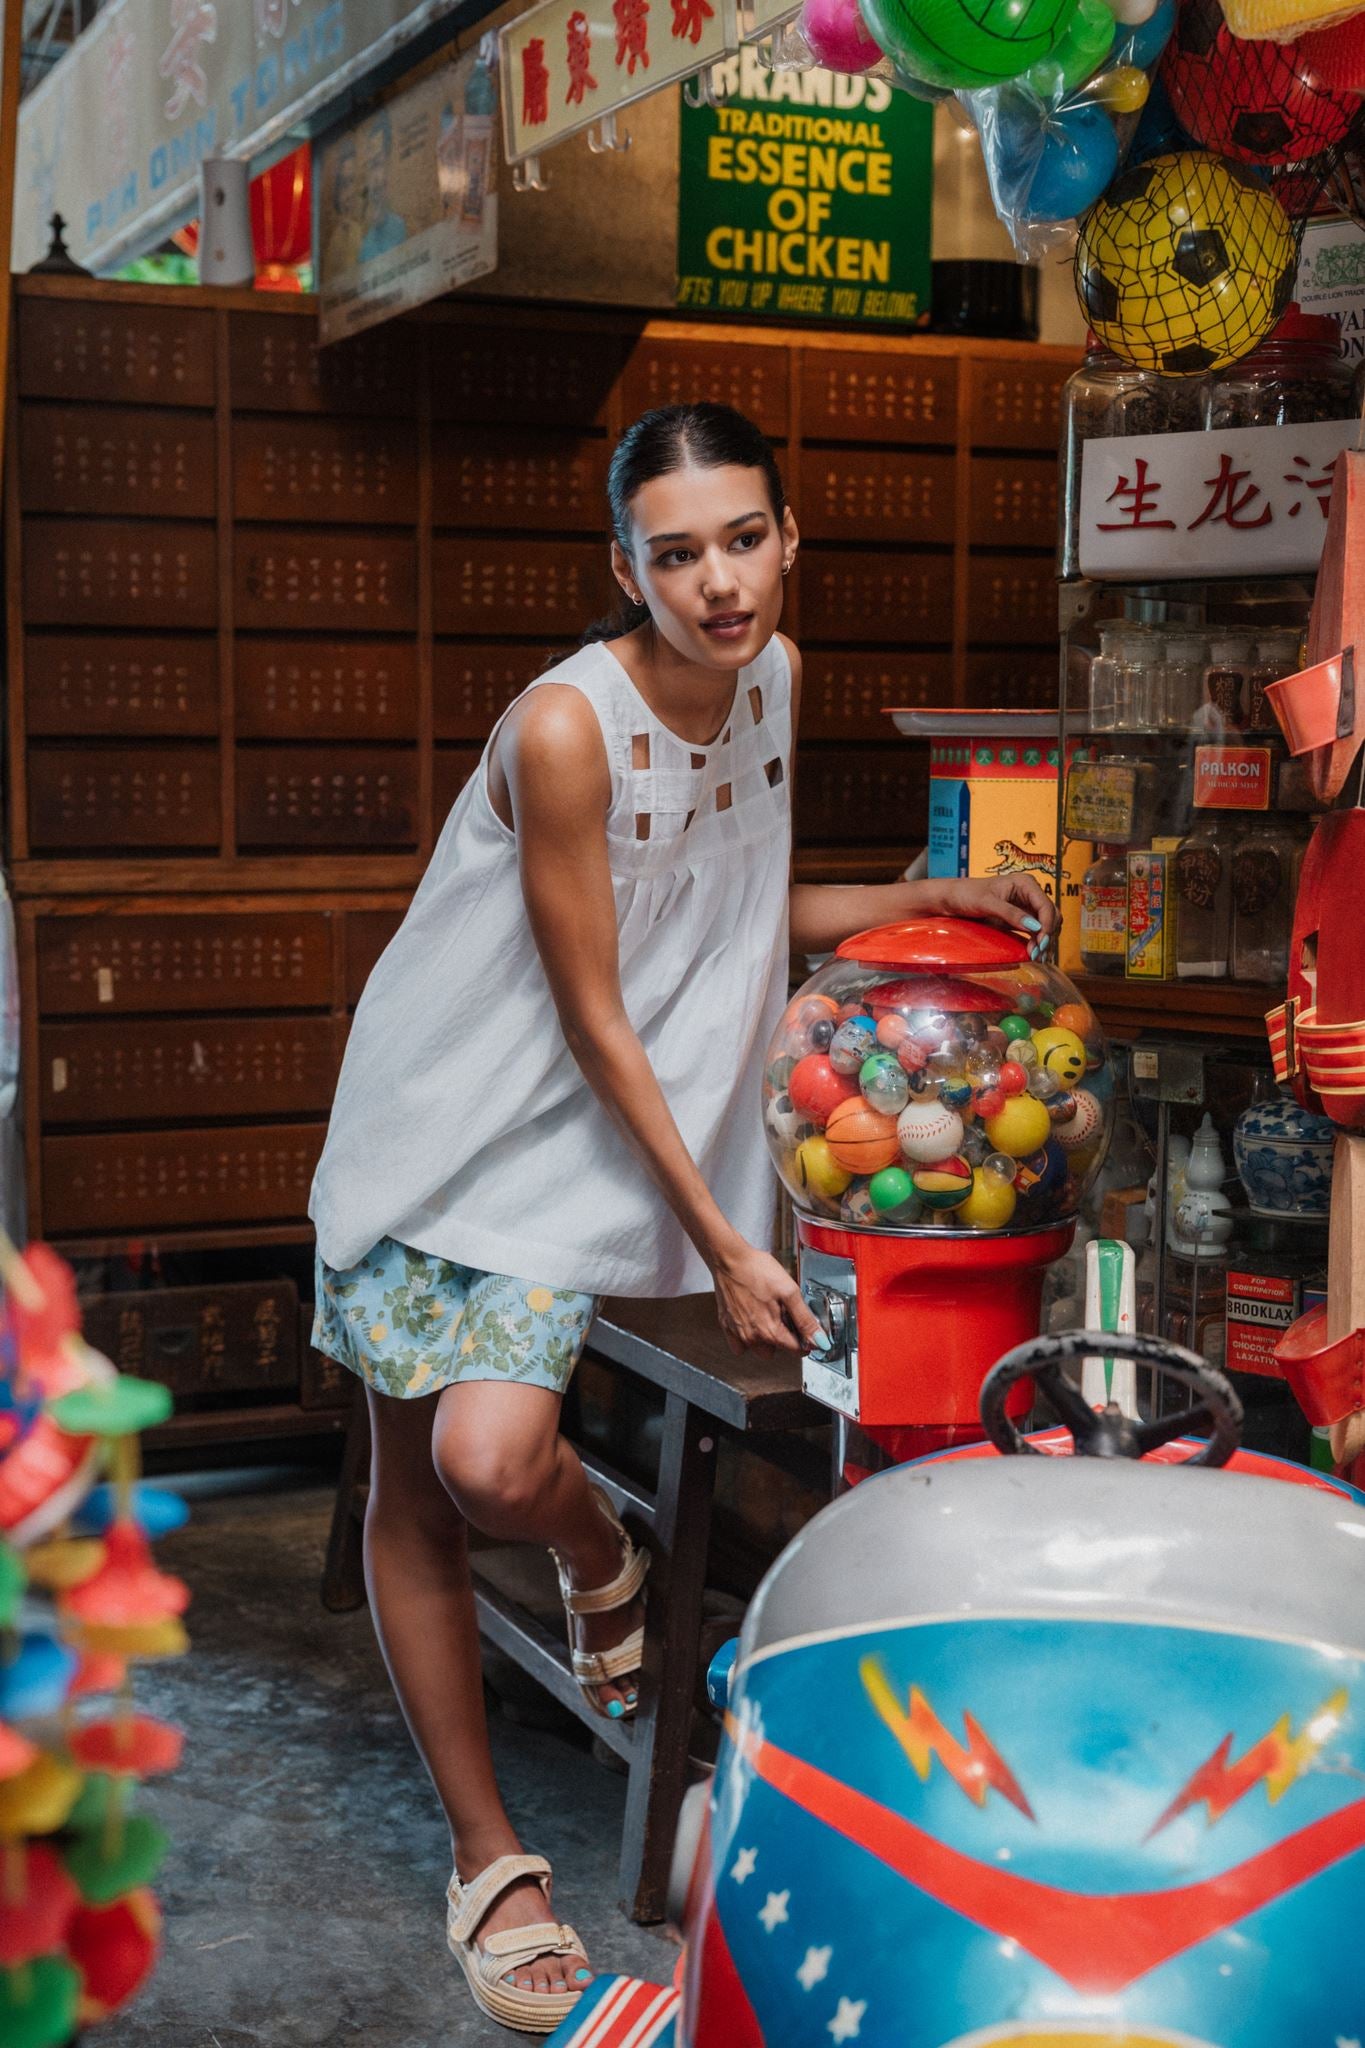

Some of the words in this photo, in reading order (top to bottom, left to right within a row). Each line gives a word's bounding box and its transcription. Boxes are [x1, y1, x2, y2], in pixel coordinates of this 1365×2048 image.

[230, 2, 345, 127] TONG
[715, 107, 885, 149] TRADITIONAL
[708, 136, 892, 197] ESSENCE
[766, 187, 832, 234] OF
[705, 225, 891, 284] CHICKEN
[718, 279, 748, 307] YOU
[751, 281, 774, 309] UP
[777, 283, 827, 314] WHERE
[831, 286, 862, 316] YOU
[1301, 293, 1328, 303] DOUBLE
[1328, 291, 1344, 301] LION
[1200, 761, 1260, 777] PALKON
[1251, 1277, 1266, 1285] FOR
[1227, 1300, 1293, 1321] BROOKLAX
